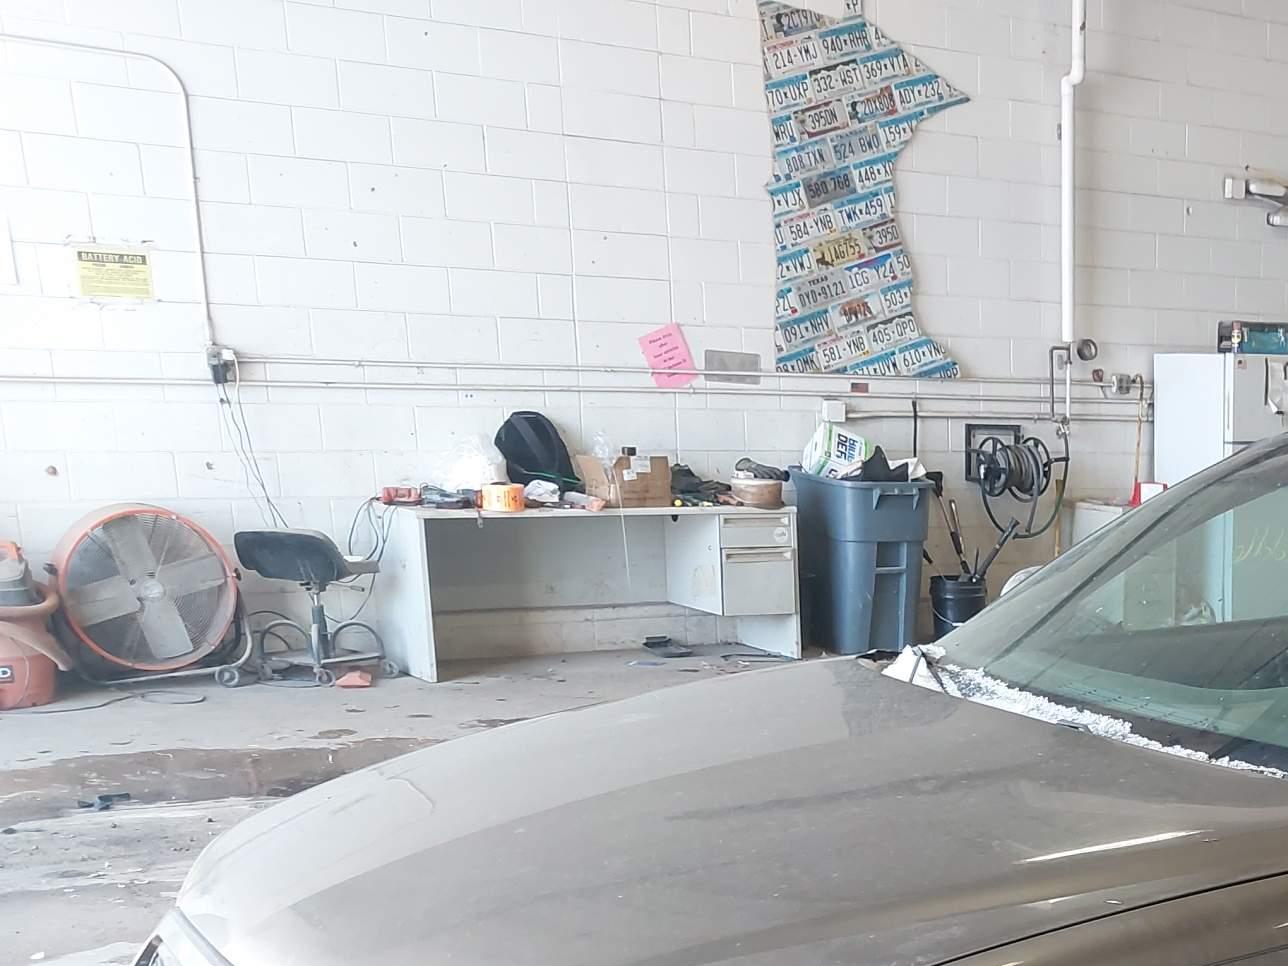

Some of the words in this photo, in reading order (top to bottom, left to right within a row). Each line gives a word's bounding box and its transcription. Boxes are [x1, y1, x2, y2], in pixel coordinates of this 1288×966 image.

[81, 252, 120, 263] BATTERY
[123, 255, 144, 264] ACID
[808, 275, 829, 287] TEXAS
